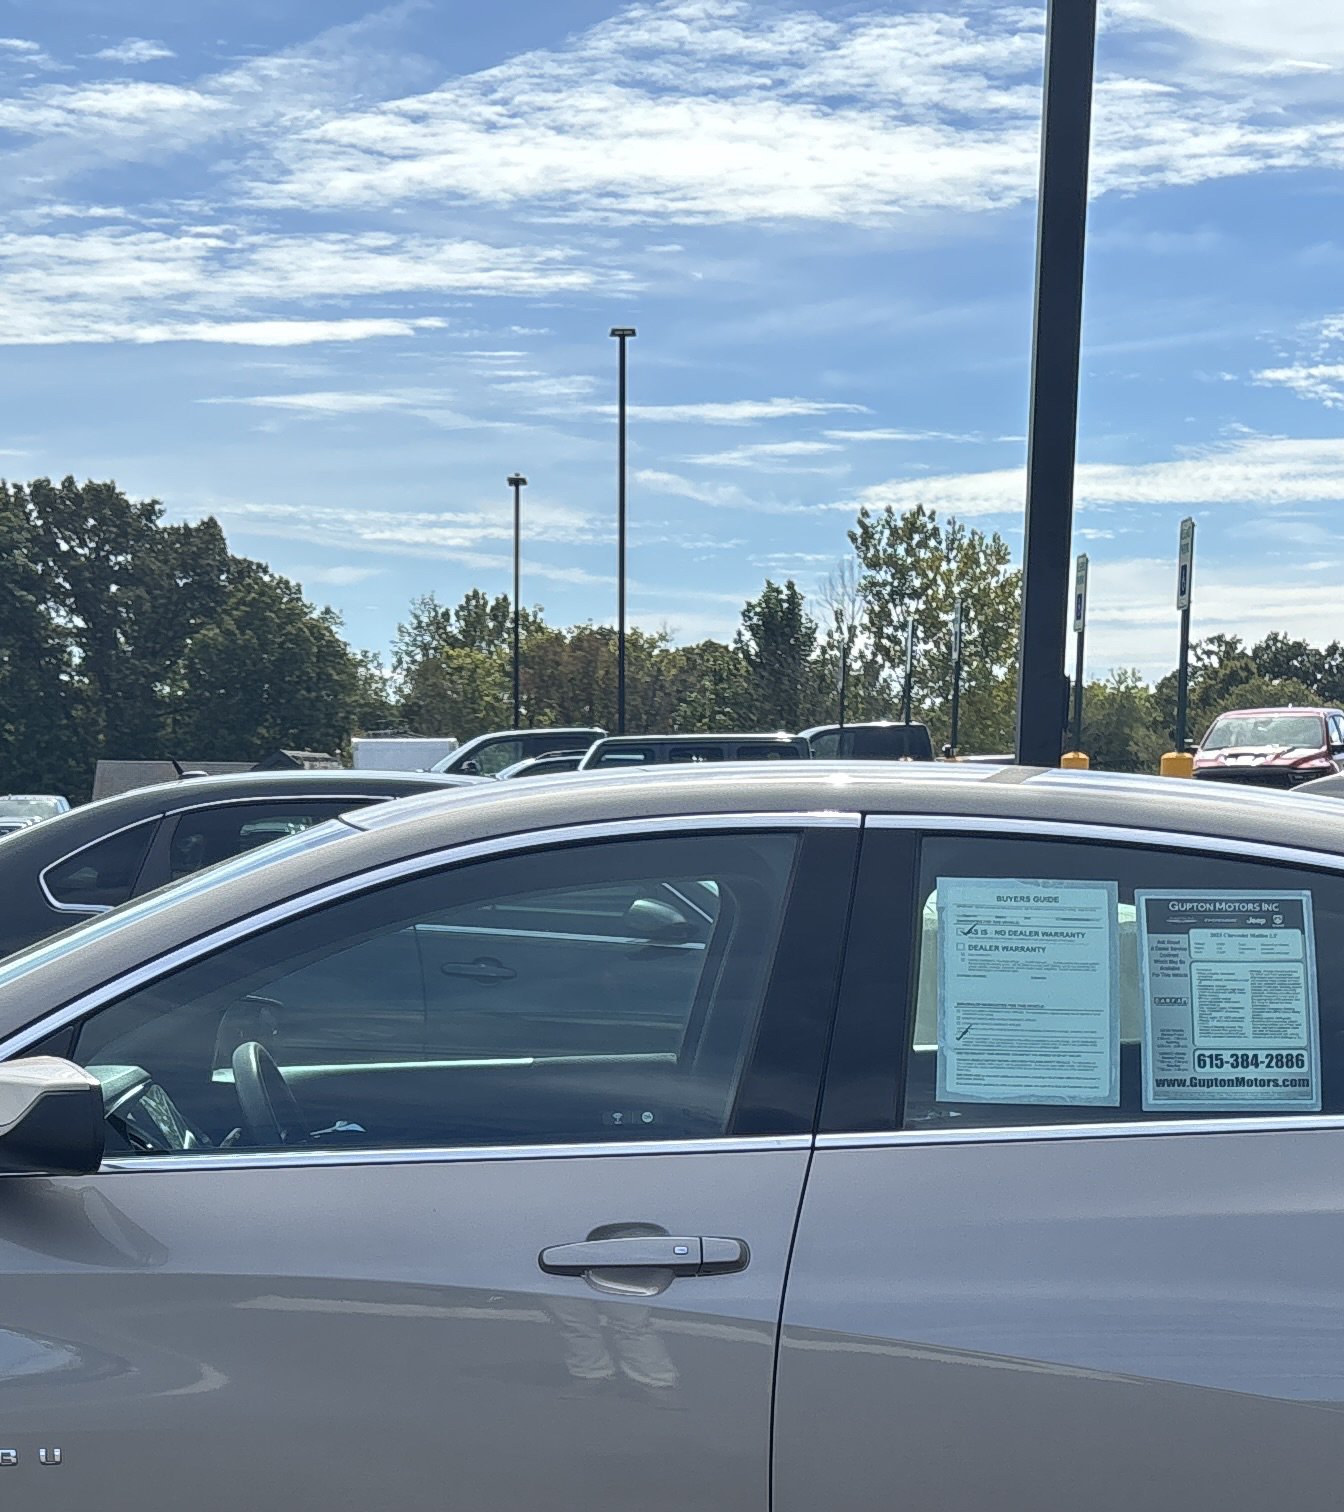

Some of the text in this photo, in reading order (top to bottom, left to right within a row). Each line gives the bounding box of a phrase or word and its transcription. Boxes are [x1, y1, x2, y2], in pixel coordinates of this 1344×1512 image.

[996, 895, 1059, 904] BUYERS GUIDE
[1168, 901, 1280, 911] GUPTON MOTORS INC
[1246, 916, 1266, 925] Jeep
[994, 929, 1006, 937] NO
[1041, 931, 1086, 939] WARRANTY
[968, 944, 1046, 953] DEALER WARRANTY
[1197, 1053, 1305, 1069] 615-384-2886
[1155, 1077, 1309, 1088] www.GuptonMotors.com
